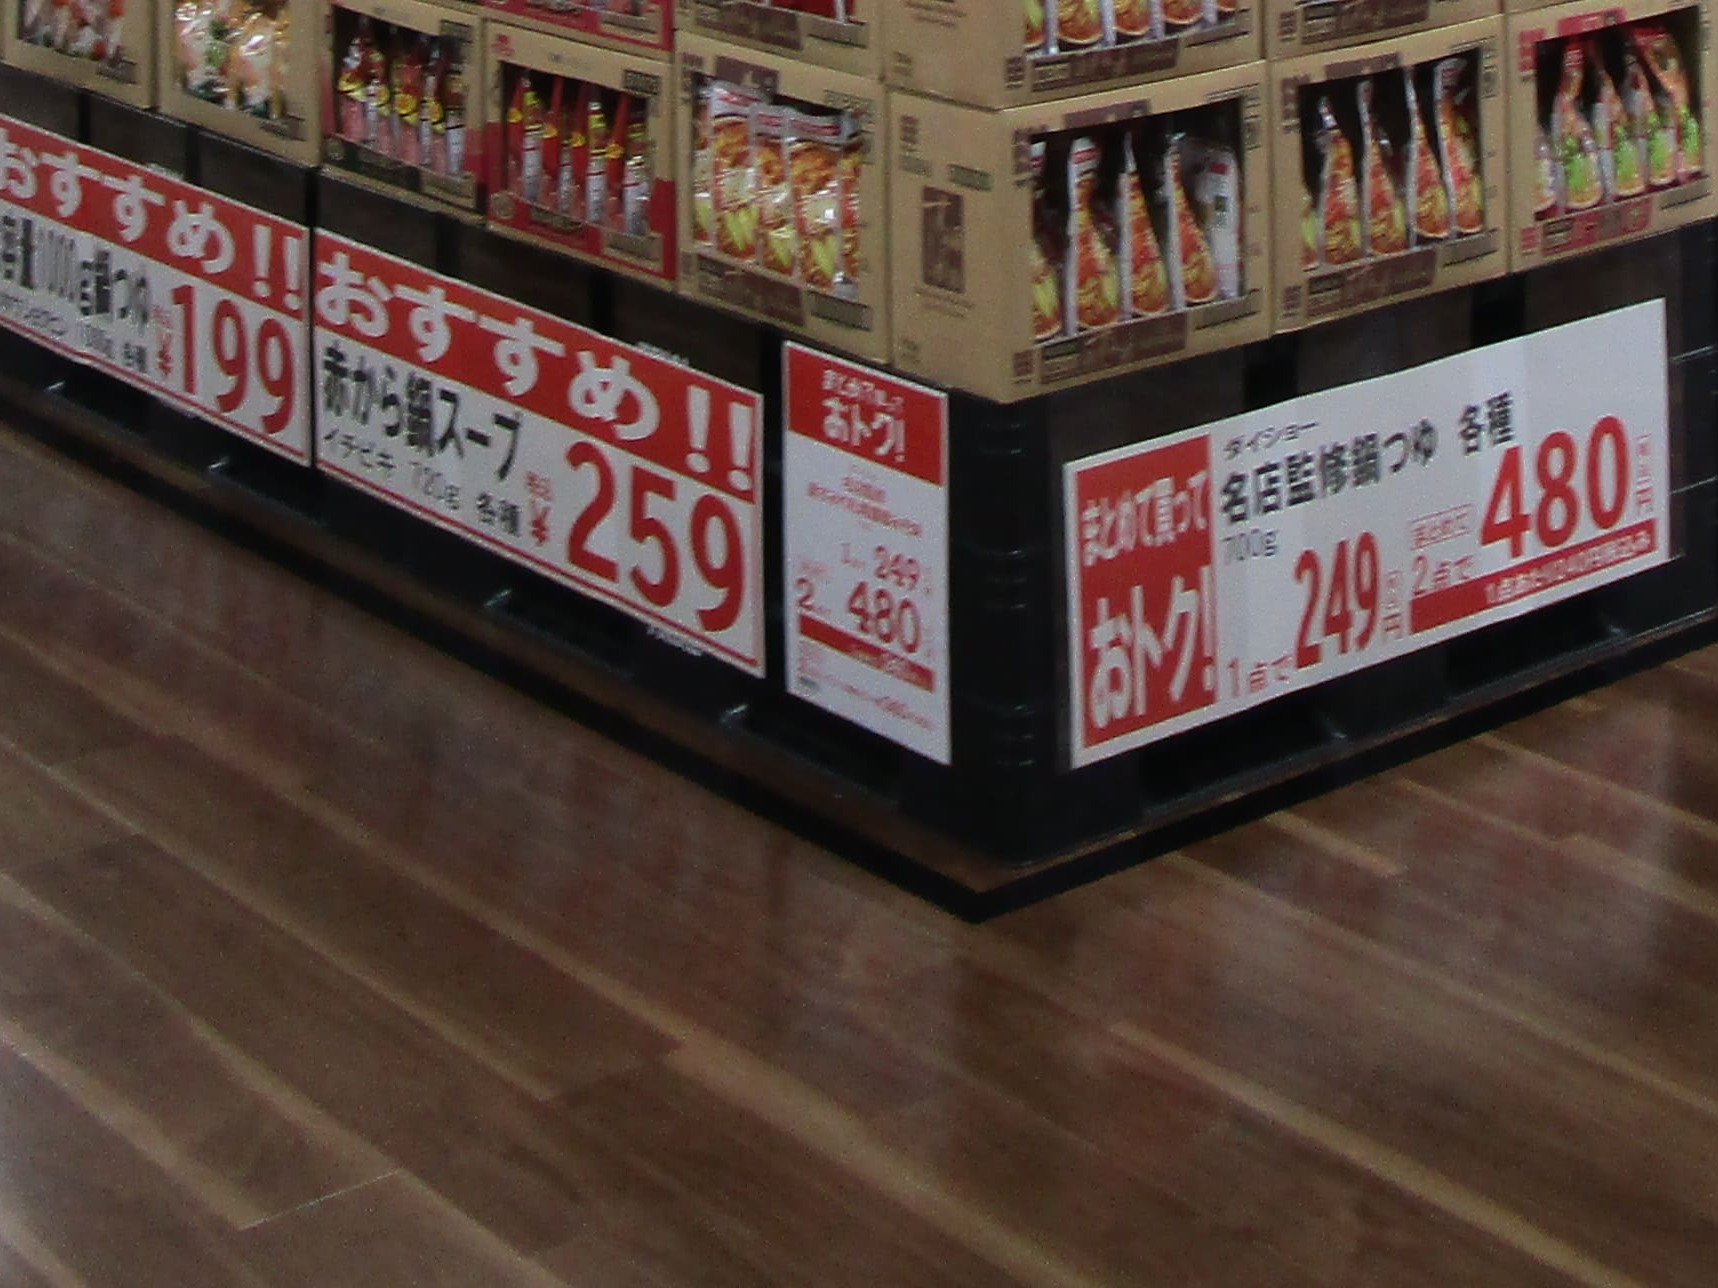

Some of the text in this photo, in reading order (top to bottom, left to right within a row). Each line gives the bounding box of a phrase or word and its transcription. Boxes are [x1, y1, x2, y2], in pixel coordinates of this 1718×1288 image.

[172, 284, 295, 434] 199
[314, 251, 755, 493] おすすめ!!
[321, 341, 525, 485] 赤から鍋スープ
[322, 430, 397, 479] イチビキ
[474, 491, 523, 541] 各種
[822, 396, 906, 463] おトク!
[1219, 390, 1515, 525] 名店監修鍋つゆ 各種
[1224, 420, 1320, 461] ダイショー
[564, 440, 744, 633] 259
[873, 546, 922, 593] 249
[1082, 469, 1210, 568] まとめて買って
[1413, 554, 1474, 597] 2点で
[1479, 415, 1630, 560] 480
[846, 579, 923, 654] 480
[1089, 566, 1217, 730] おトク!
[1226, 652, 1294, 700] 1点で
[1293, 532, 1378, 671] 249
